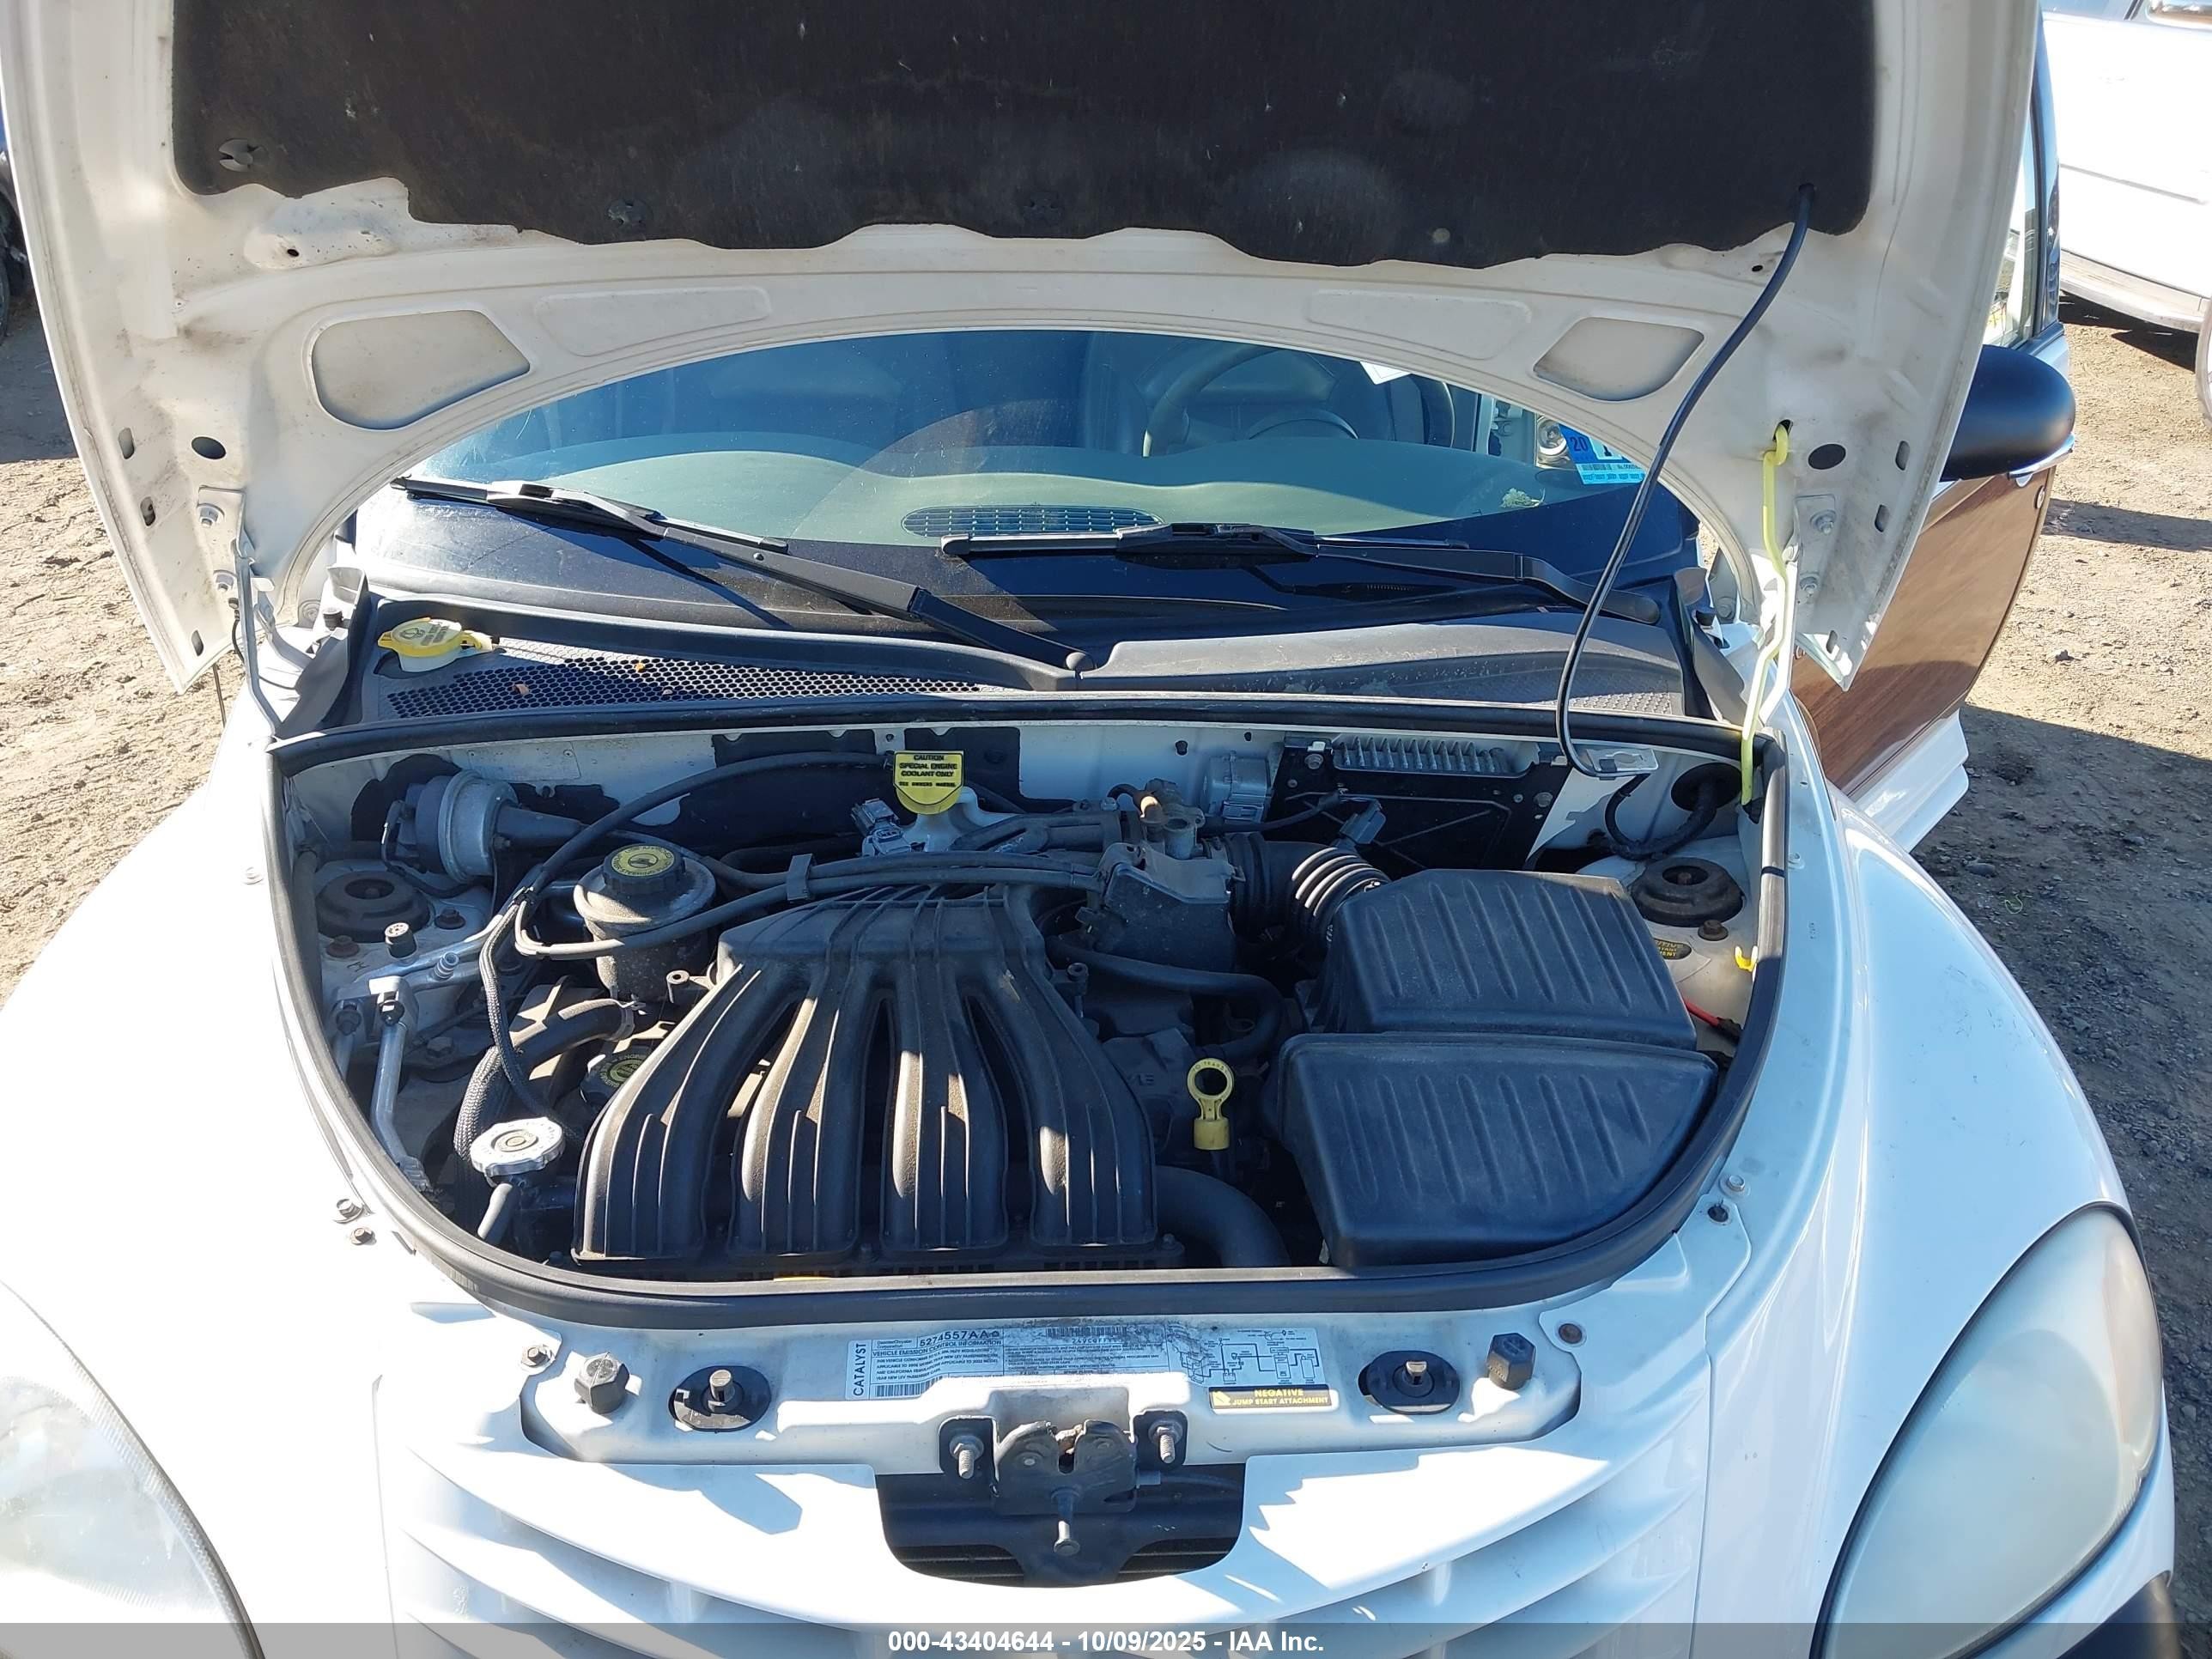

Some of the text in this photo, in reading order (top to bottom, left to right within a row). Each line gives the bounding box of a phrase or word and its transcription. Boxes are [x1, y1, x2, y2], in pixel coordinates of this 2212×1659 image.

[1571, 436, 1588, 451] 20
[920, 1330, 990, 1347] 5274557AA
[898, 1347, 928, 1356] EMISSION
[928, 1340, 957, 1352] CONTROL
[853, 1343, 866, 1396] CATALYST
[1254, 1389, 1304, 1397] NEGATIVE
[1278, 1396, 1328, 1406] ATTACHMENT
